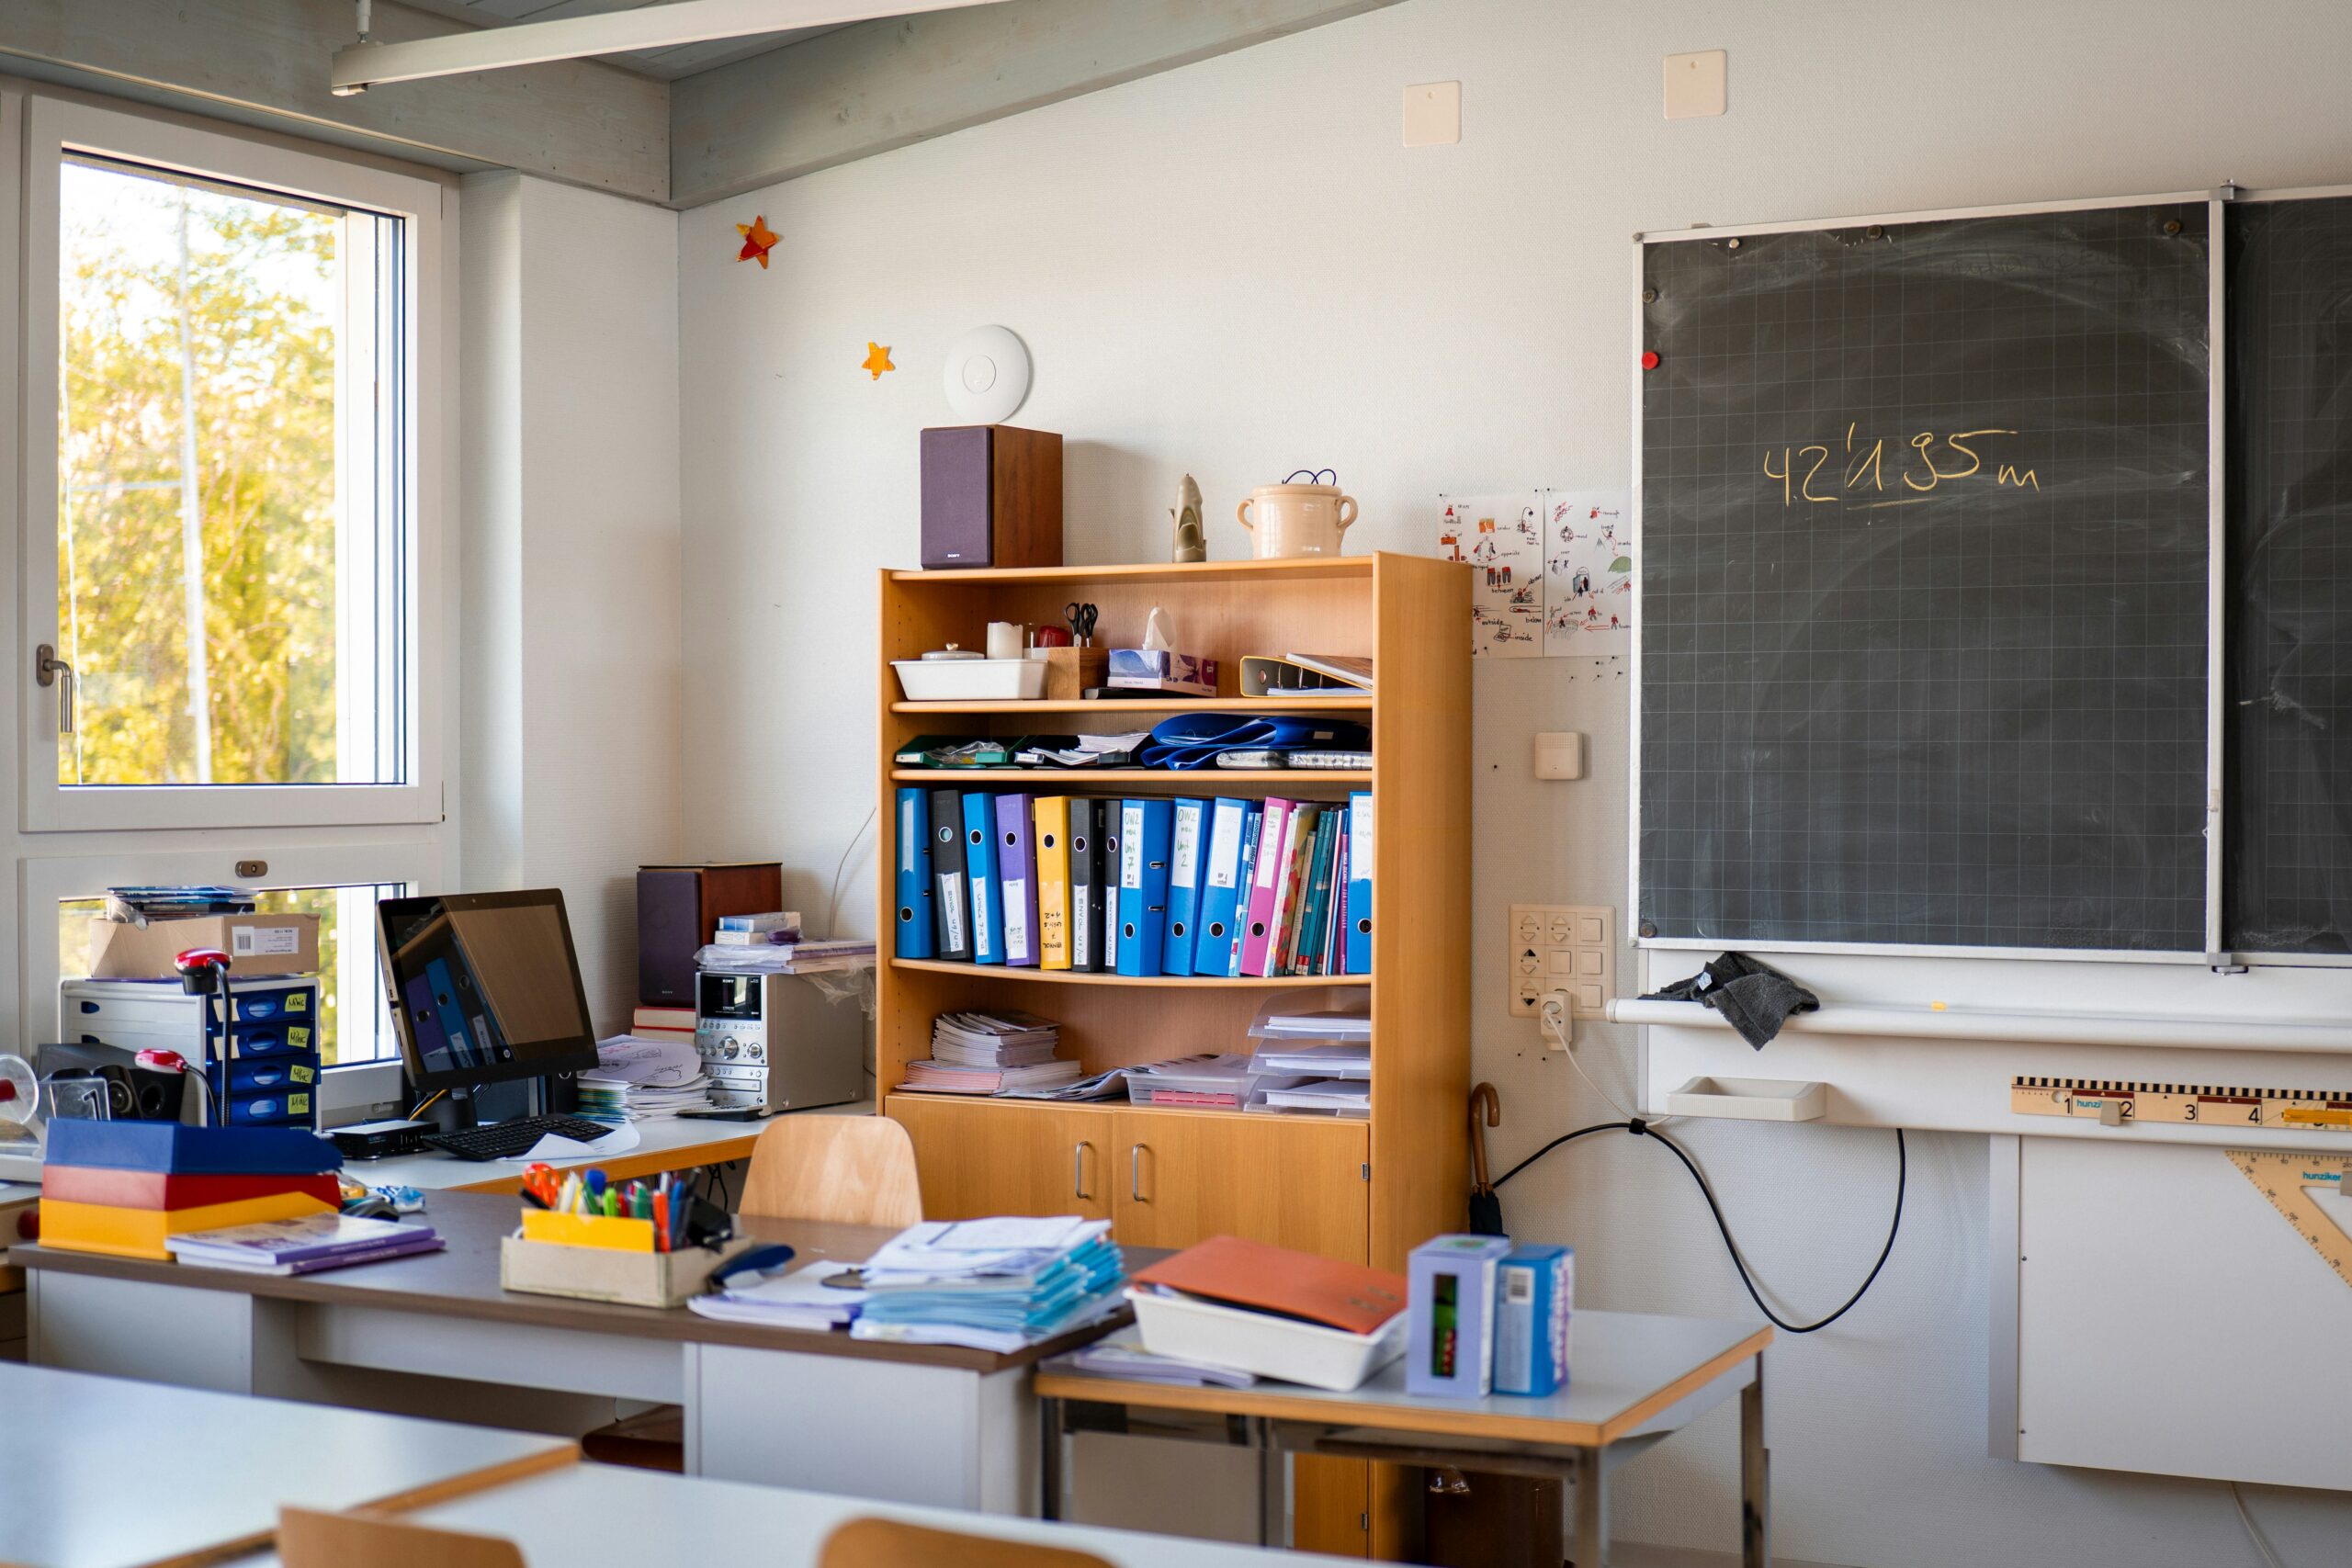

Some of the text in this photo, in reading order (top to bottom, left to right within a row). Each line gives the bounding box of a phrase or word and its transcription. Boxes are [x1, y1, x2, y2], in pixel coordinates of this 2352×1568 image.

[1998, 463, 2040, 492] m
[2064, 1097, 2071, 1114] 1
[2120, 1100, 2132, 1118] 2
[2184, 1104, 2196, 1121] 3
[2247, 1107, 2260, 1123] 4
[2302, 1170, 2342, 1181] hunziker
